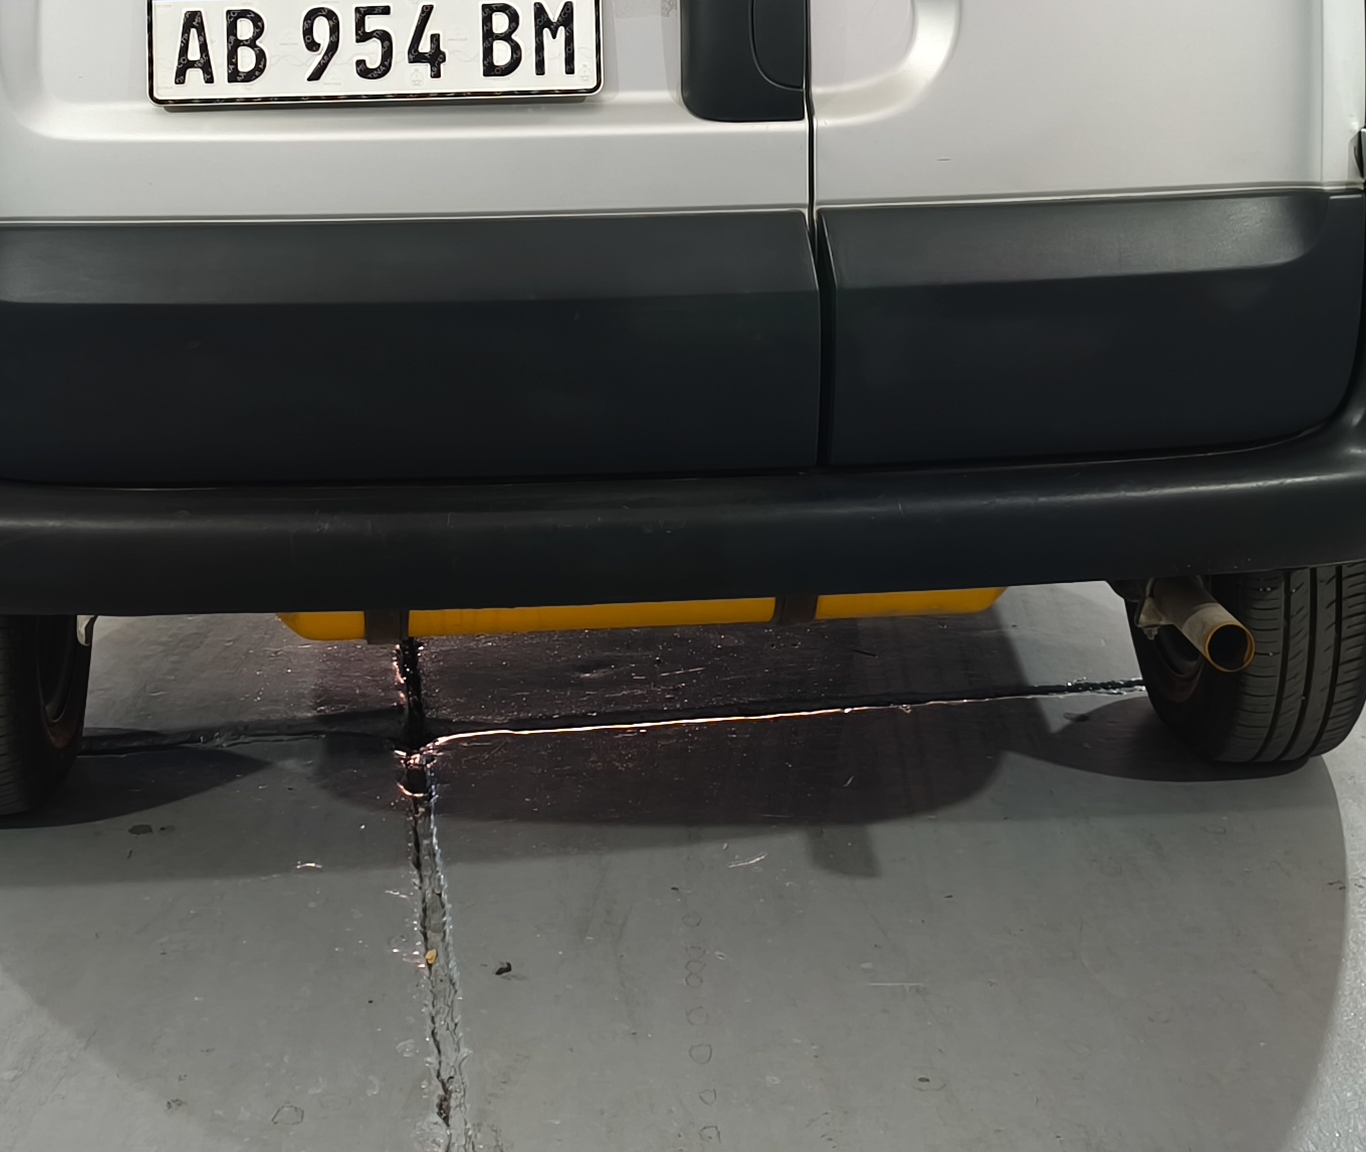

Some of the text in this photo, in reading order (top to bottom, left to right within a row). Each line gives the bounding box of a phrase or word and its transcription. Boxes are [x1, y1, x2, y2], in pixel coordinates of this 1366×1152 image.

[174, 0, 575, 85] AB 954 BM
